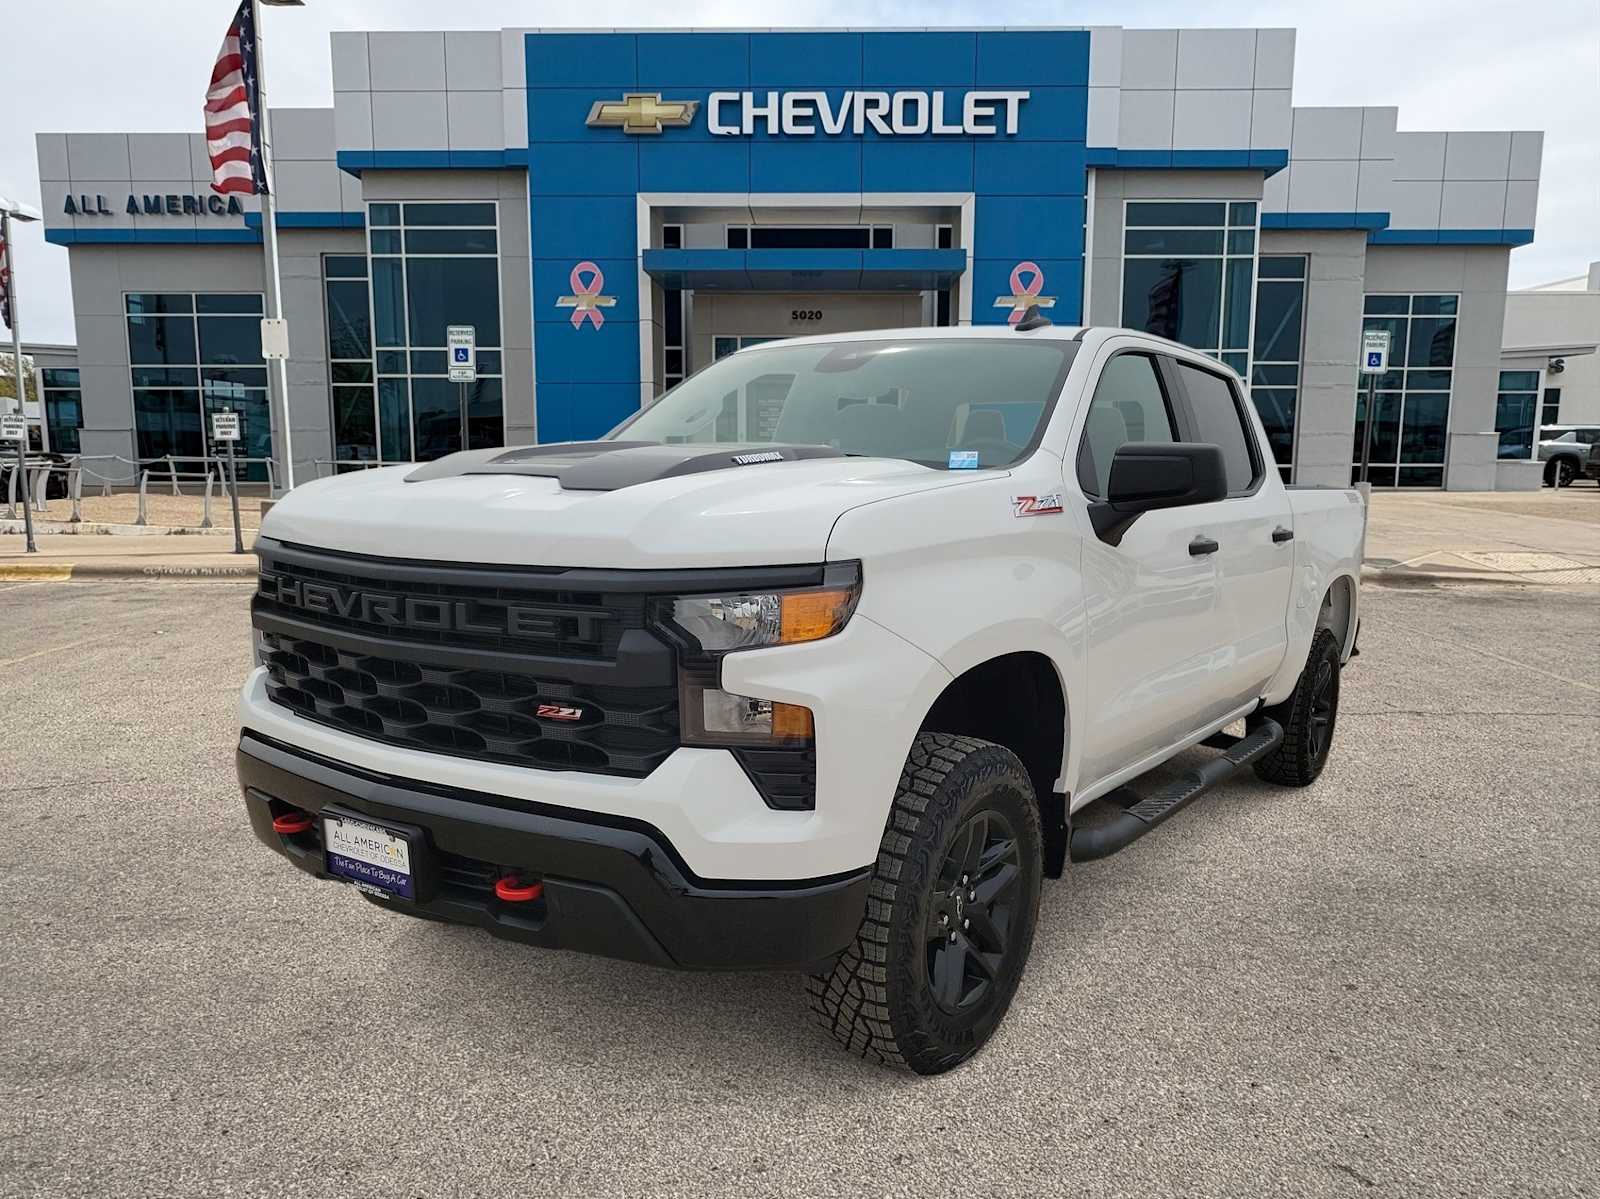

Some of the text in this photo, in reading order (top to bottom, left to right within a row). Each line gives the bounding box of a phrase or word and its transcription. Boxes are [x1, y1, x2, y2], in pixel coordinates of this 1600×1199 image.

[707, 91, 1031, 136] CHEVROLET
[64, 195, 112, 215] ALL
[792, 310, 823, 320] 5020
[1011, 494, 1064, 518] Z71
[259, 572, 616, 641] CHEVROLET
[536, 704, 582, 720] Z71
[334, 830, 351, 843] ALL
